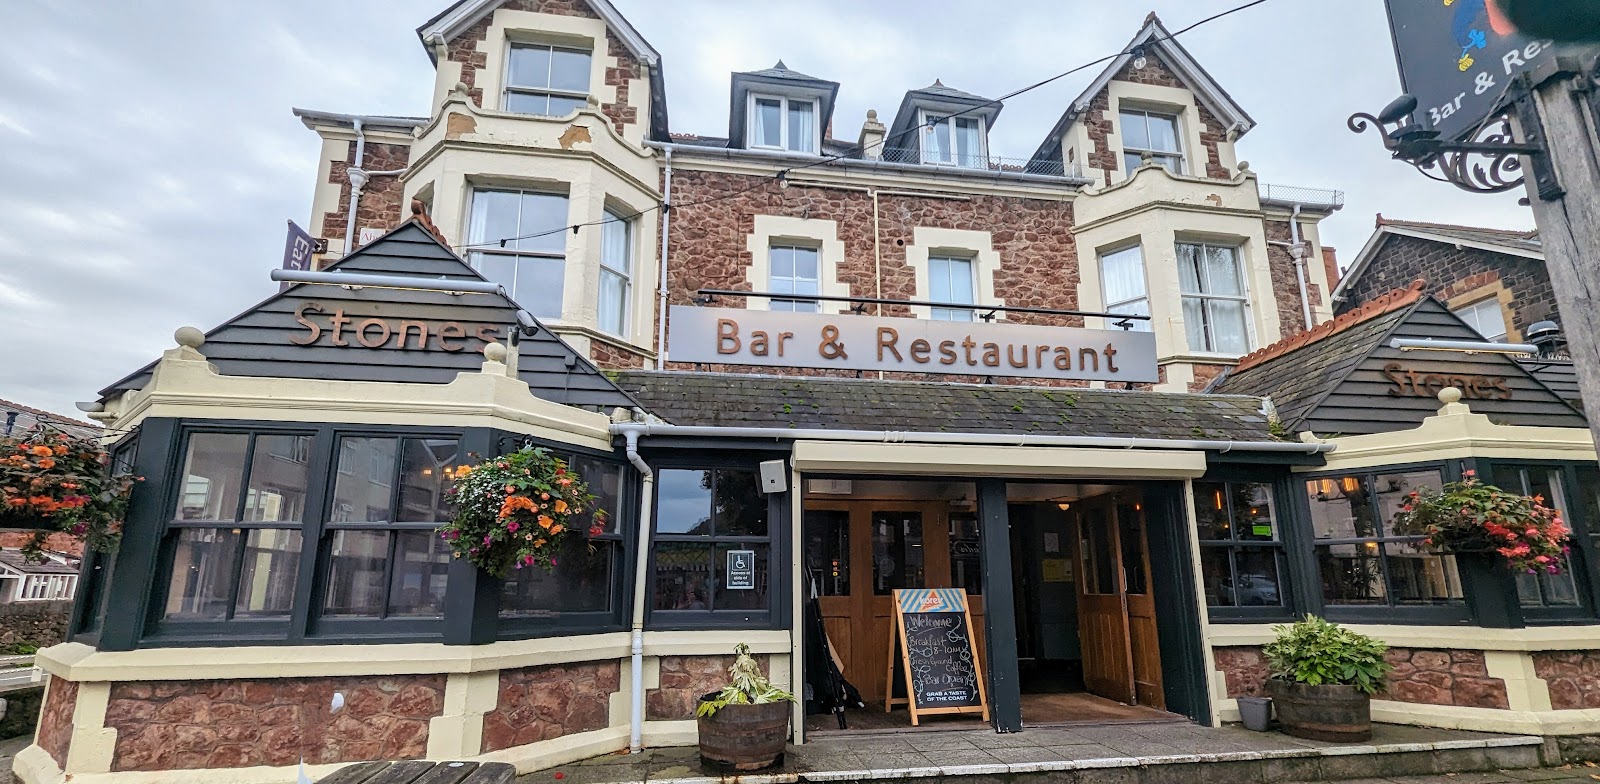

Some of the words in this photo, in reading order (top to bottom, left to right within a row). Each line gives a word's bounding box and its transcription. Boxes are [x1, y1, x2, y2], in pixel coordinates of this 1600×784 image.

[1474, 71, 1496, 96] &
[288, 302, 501, 354] Stones
[716, 318, 794, 356] Bar
[818, 324, 849, 360] &
[877, 326, 1120, 374] Restaurant
[1383, 362, 1513, 400] Stones
[909, 614, 952, 628] Welcome
[909, 634, 947, 650] Breakfast
